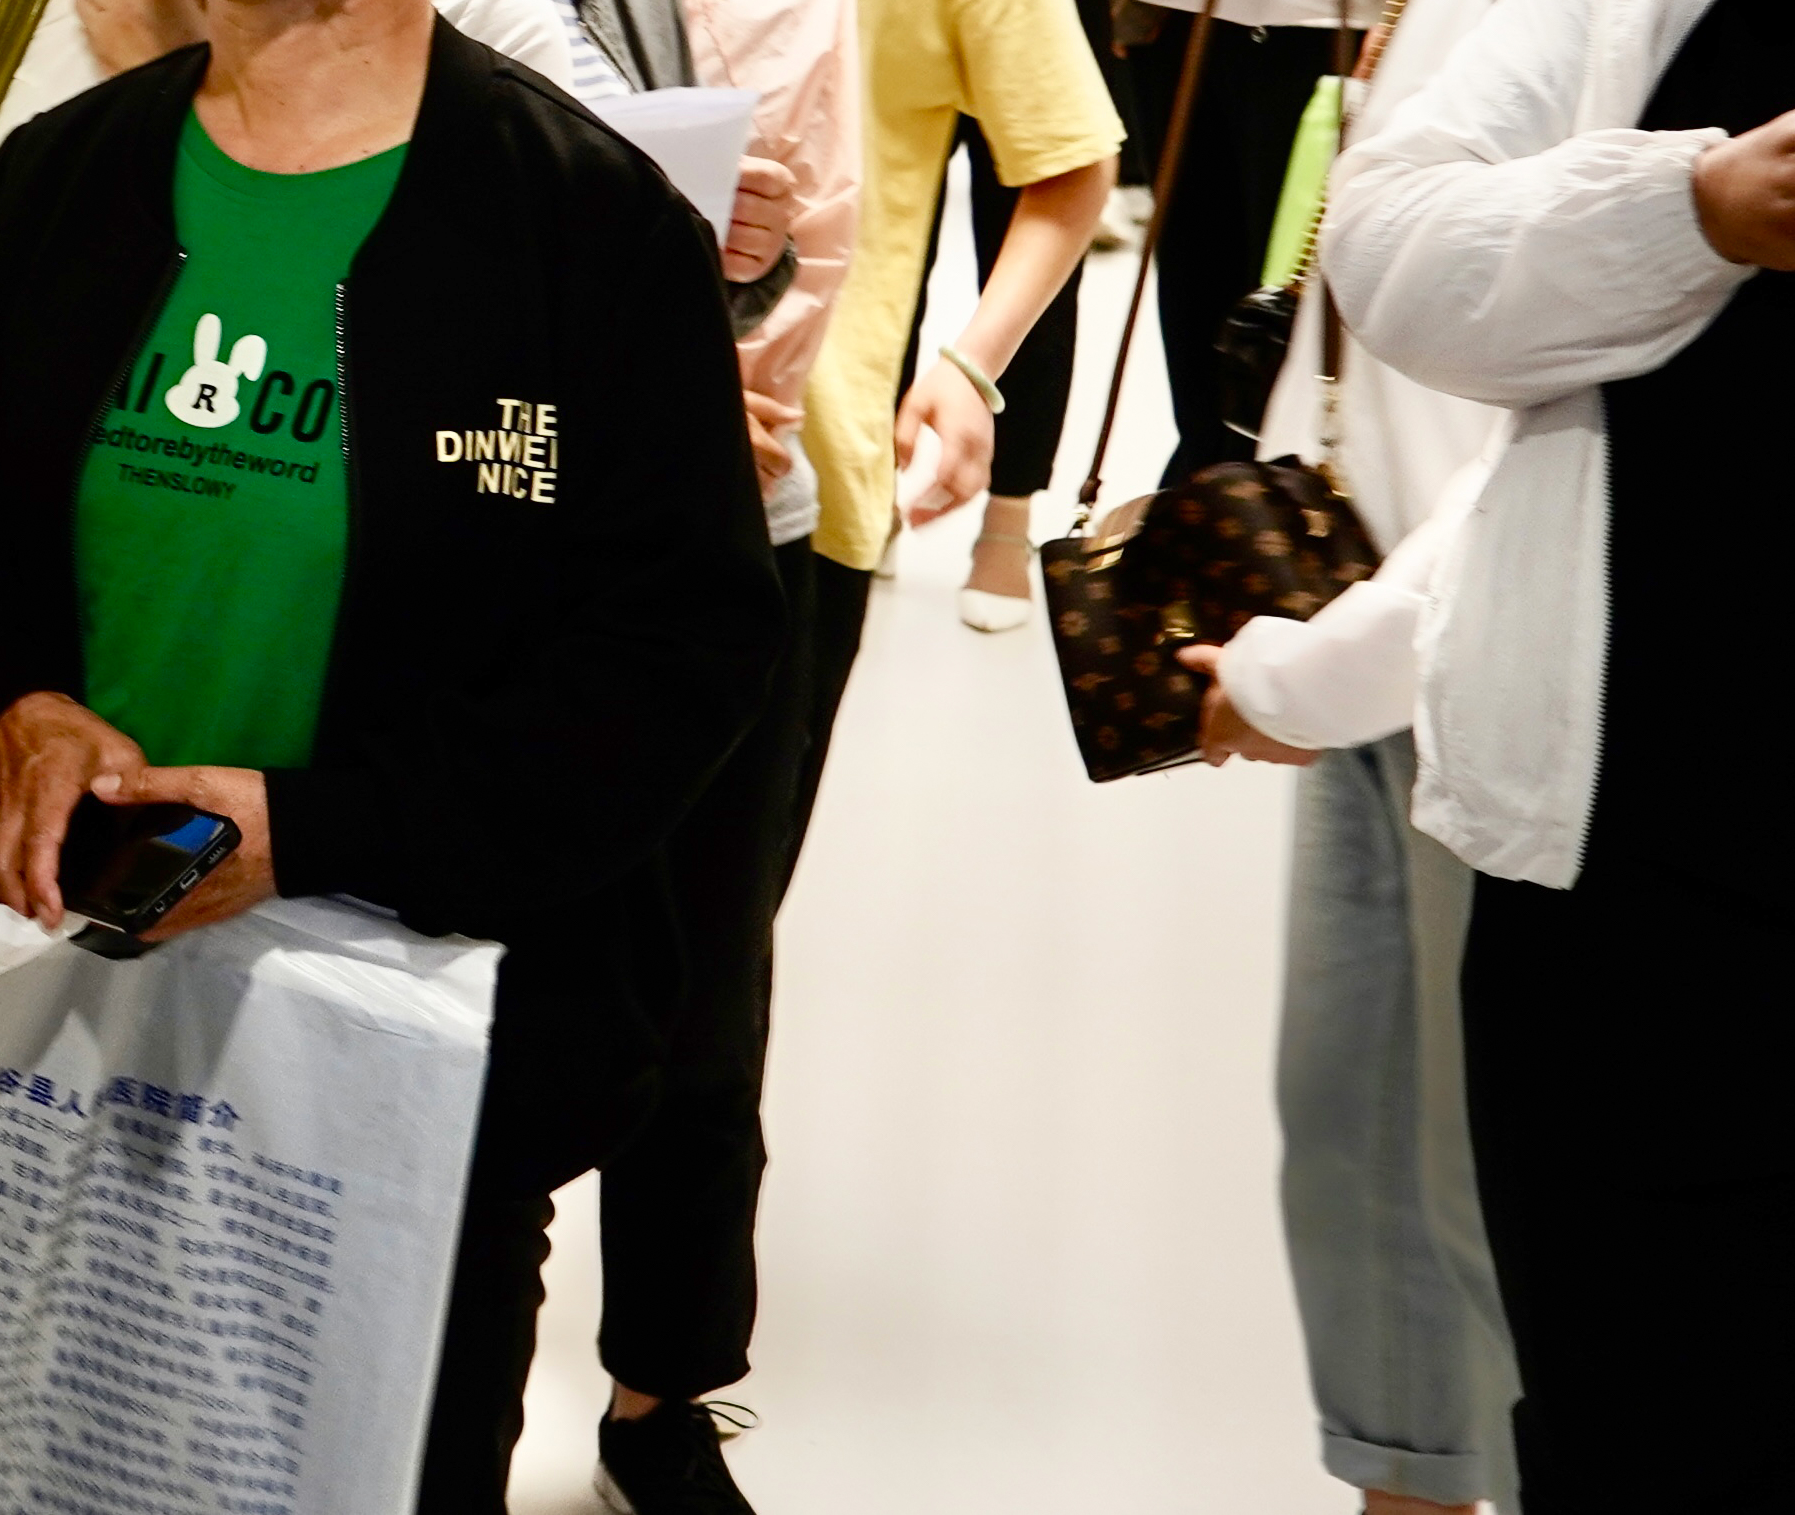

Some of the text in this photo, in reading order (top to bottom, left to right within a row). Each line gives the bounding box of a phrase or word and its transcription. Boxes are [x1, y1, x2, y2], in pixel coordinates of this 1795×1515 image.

[191, 382, 218, 414] R
[496, 398, 558, 437] THE
[436, 429, 558, 470] DINWEI
[477, 462, 557, 504] NICE
